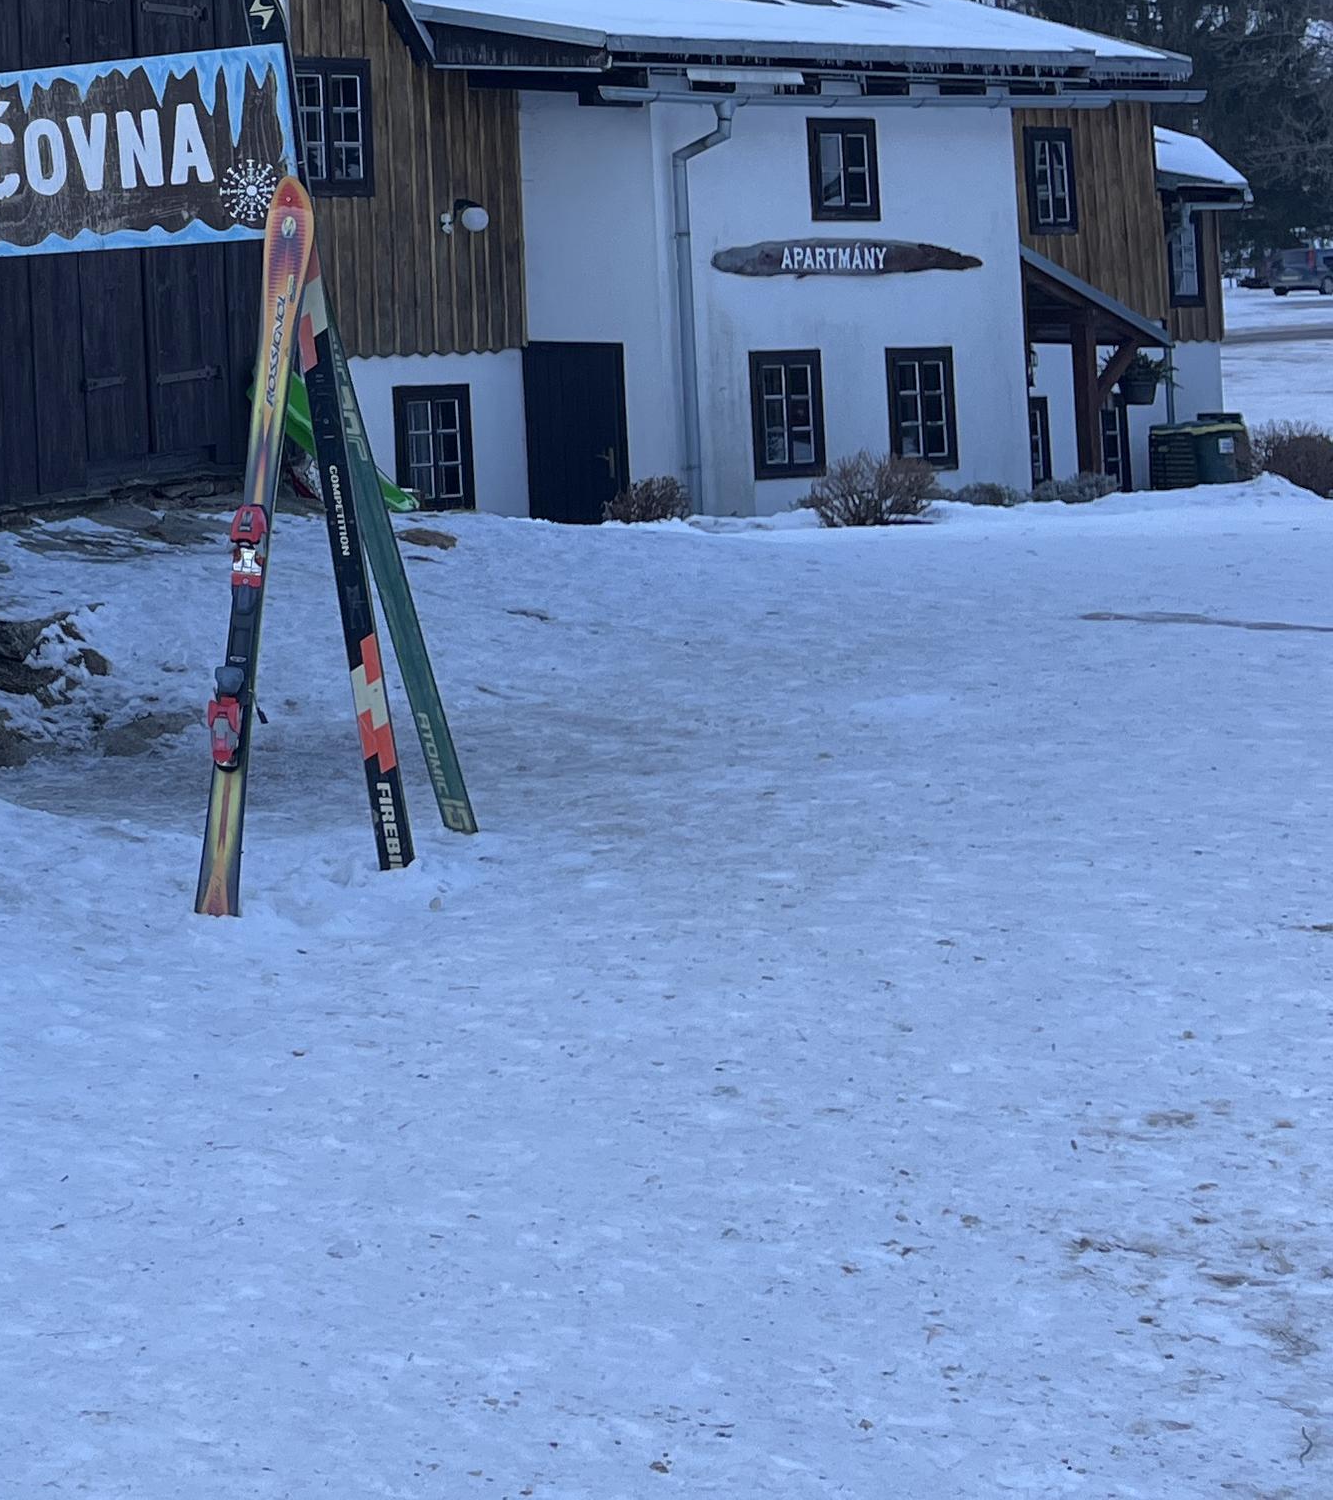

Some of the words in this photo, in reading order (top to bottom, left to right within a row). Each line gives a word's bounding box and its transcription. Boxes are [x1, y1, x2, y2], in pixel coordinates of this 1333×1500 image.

[781, 242, 887, 269] APARTMÁNY
[266, 295, 286, 406] ROSSIGNOL
[329, 465, 351, 557] COMPETITION
[417, 712, 449, 794] ATOMIC
